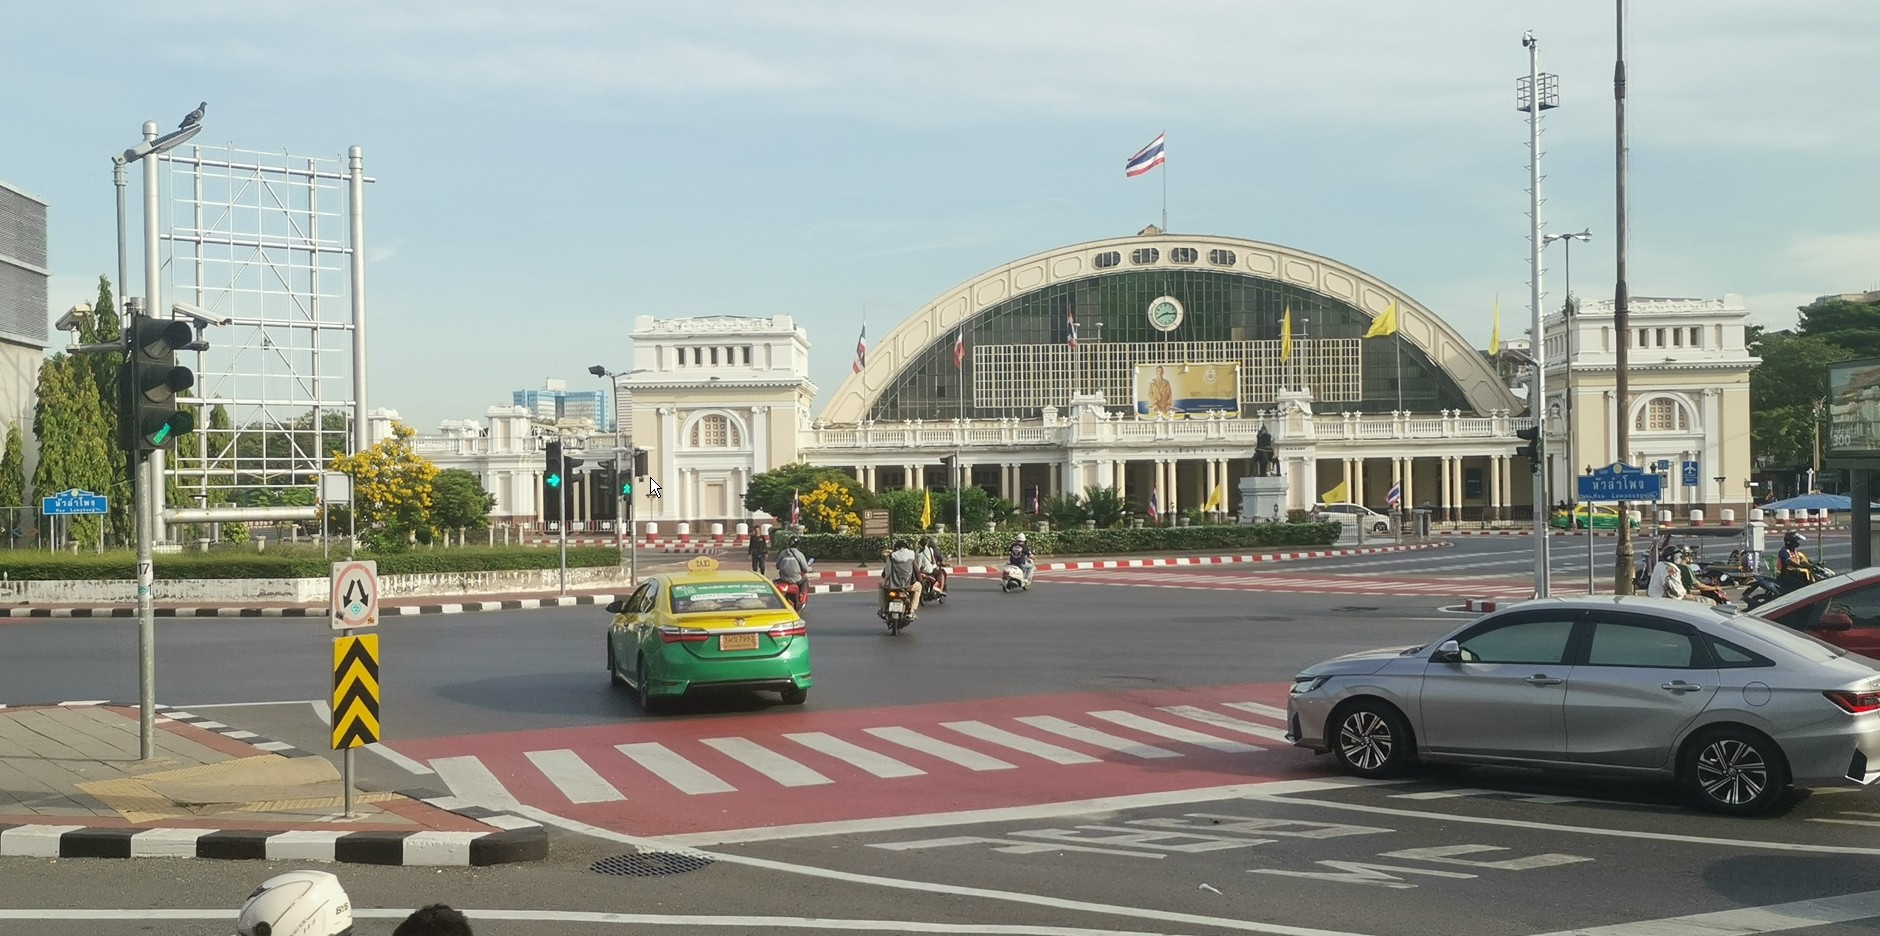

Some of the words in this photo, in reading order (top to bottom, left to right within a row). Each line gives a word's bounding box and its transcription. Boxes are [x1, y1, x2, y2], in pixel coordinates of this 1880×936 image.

[1592, 475, 1644, 490] หัวลำโพง
[137, 562, 150, 575] 17
[1247, 842, 1596, 890] MC
